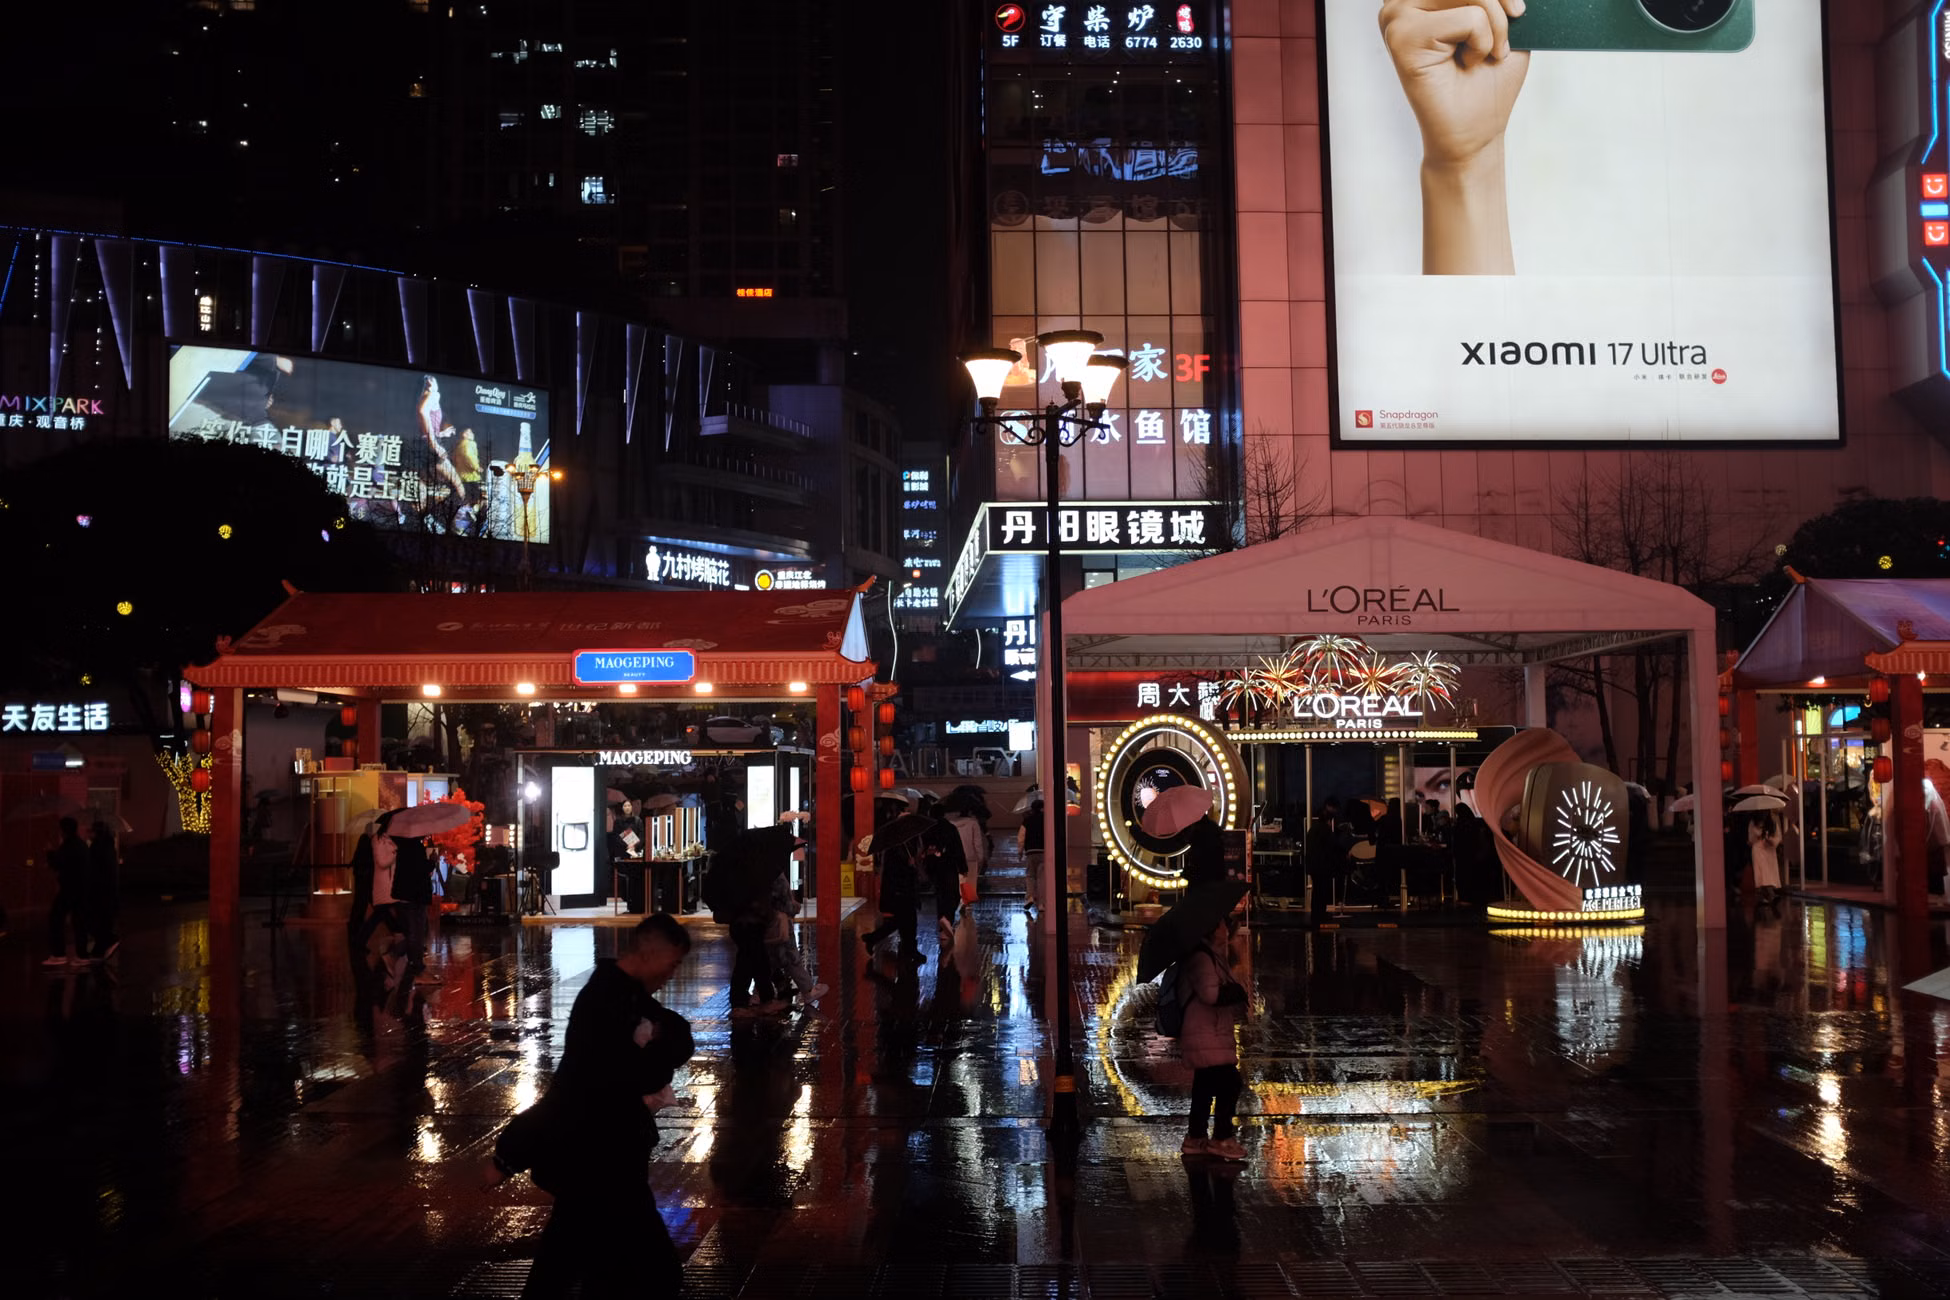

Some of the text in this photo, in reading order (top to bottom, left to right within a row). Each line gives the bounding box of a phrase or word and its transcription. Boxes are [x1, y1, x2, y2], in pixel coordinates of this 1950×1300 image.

[1039, 4, 1155, 33] 守柴炉
[1002, 34, 1203, 49] 5F 订餐 电话 6774 2630
[1461, 341, 1707, 366] xiaomi 17 Ultra
[1175, 353, 1210, 383] 3F
[1379, 410, 1438, 421] Snapdragon
[1001, 510, 1206, 544] 丹阳眼镜城
[662, 551, 730, 586] 九村烤脑花
[1308, 585, 1460, 614] L'ORÉAL
[1357, 615, 1412, 625] PARIS
[594, 656, 675, 669] MAOGEPING
[2, 703, 109, 732] 天友生活
[1336, 719, 1383, 729] PARIS
[599, 750, 692, 766] MAOGEPING
[1581, 899, 1600, 912] AGE
